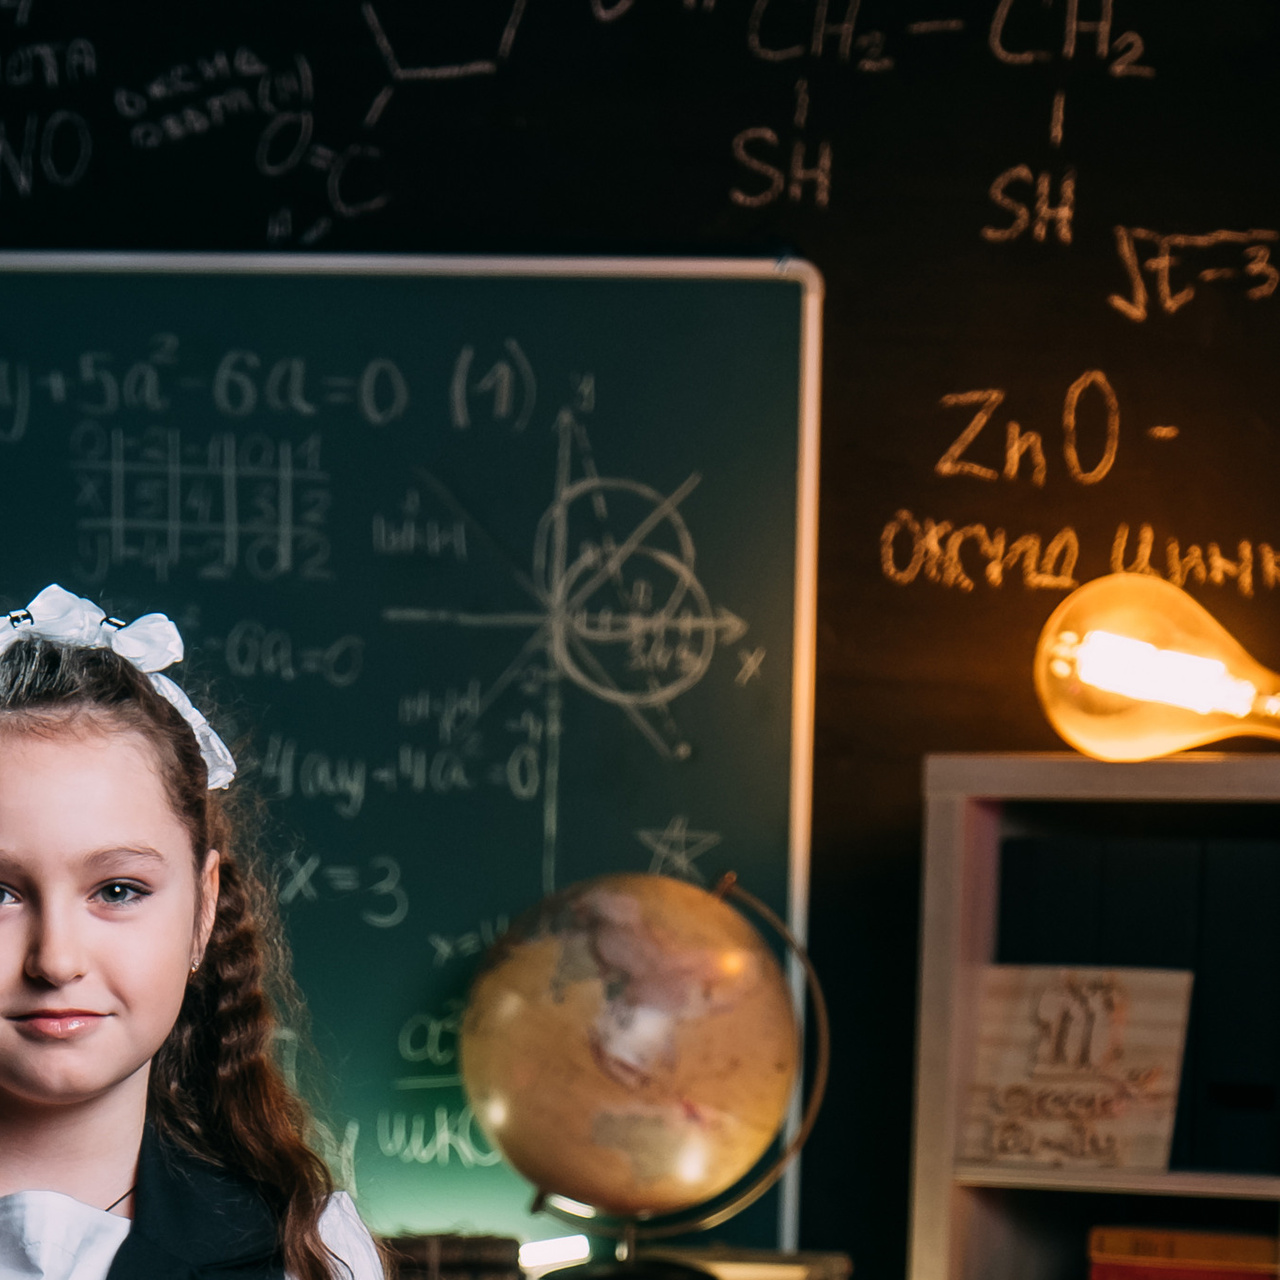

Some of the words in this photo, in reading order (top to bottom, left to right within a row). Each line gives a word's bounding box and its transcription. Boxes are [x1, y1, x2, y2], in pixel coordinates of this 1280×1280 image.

[728, 126, 833, 211] SH
[979, 163, 1078, 245] SH
[933, 368, 1121, 488] ZnO
